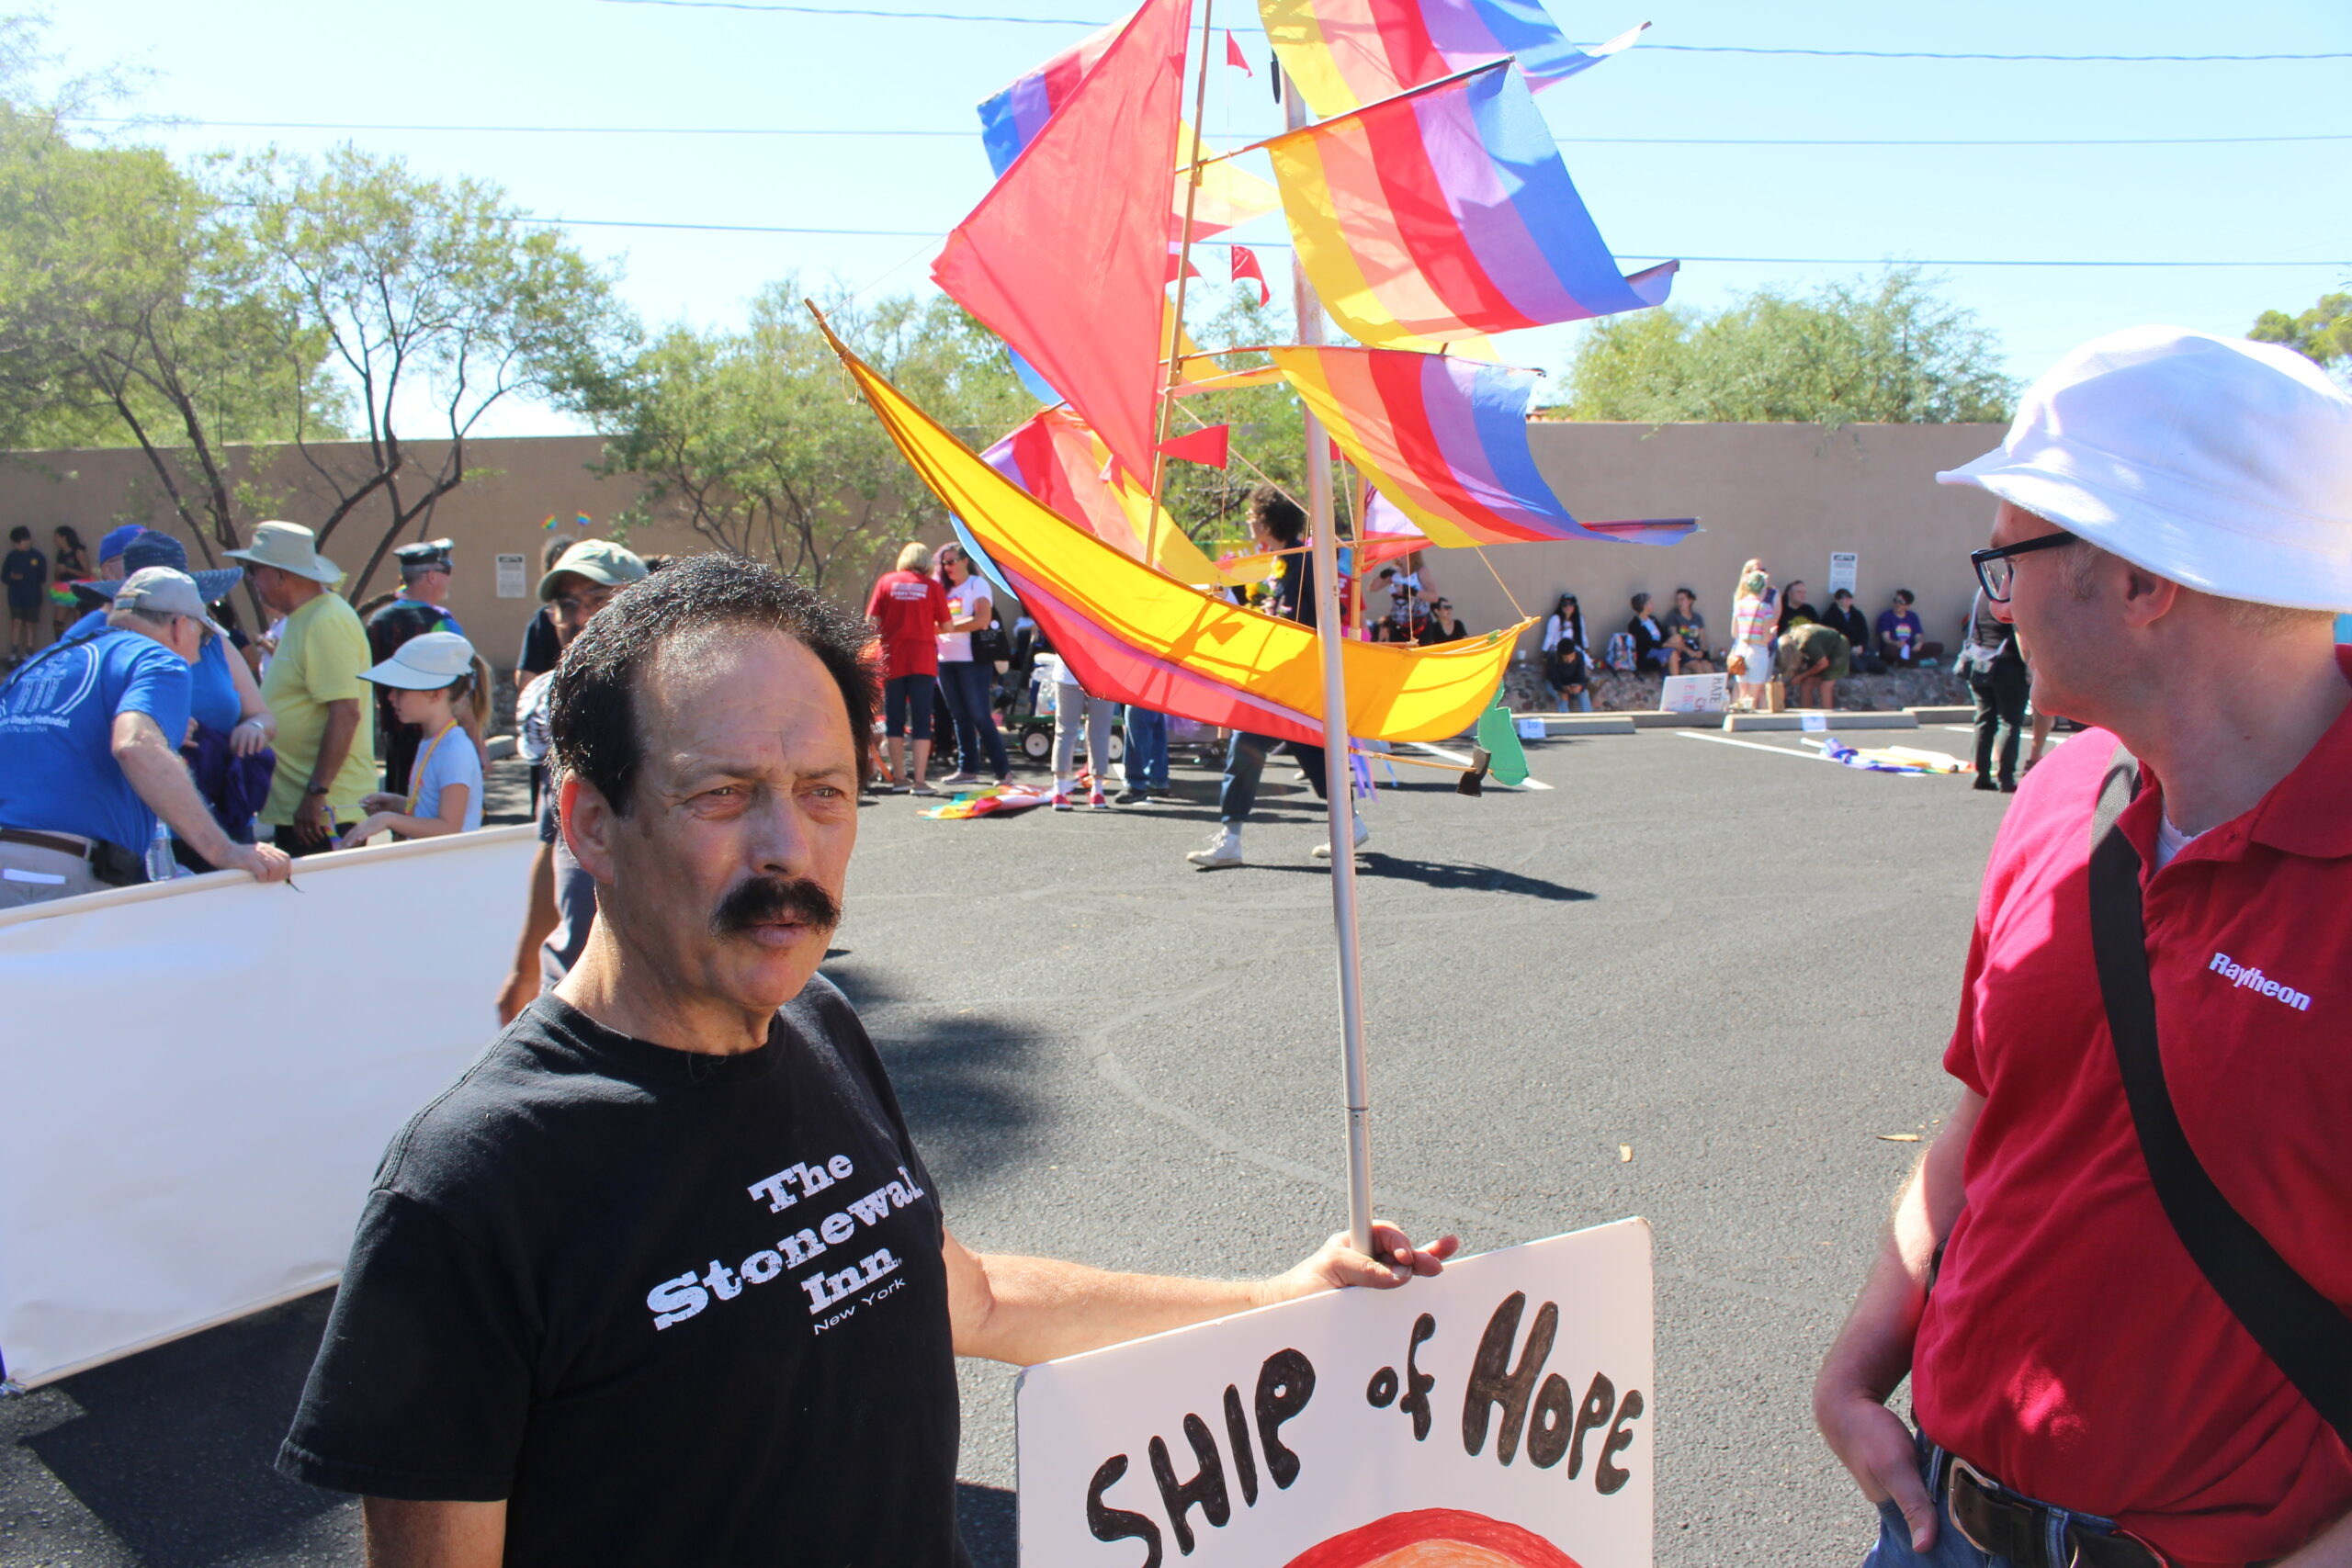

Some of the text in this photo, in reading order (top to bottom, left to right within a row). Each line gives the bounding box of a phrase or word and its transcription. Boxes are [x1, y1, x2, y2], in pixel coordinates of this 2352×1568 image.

[2209, 952, 2312, 1011] Raytheon
[747, 1154, 854, 1213] The
[647, 1166, 925, 1331] Stonewal
[800, 1247, 899, 1315] Inn
[813, 1278, 906, 1336] New York
[1086, 1290, 1645, 1568] SHIP of HOPE
